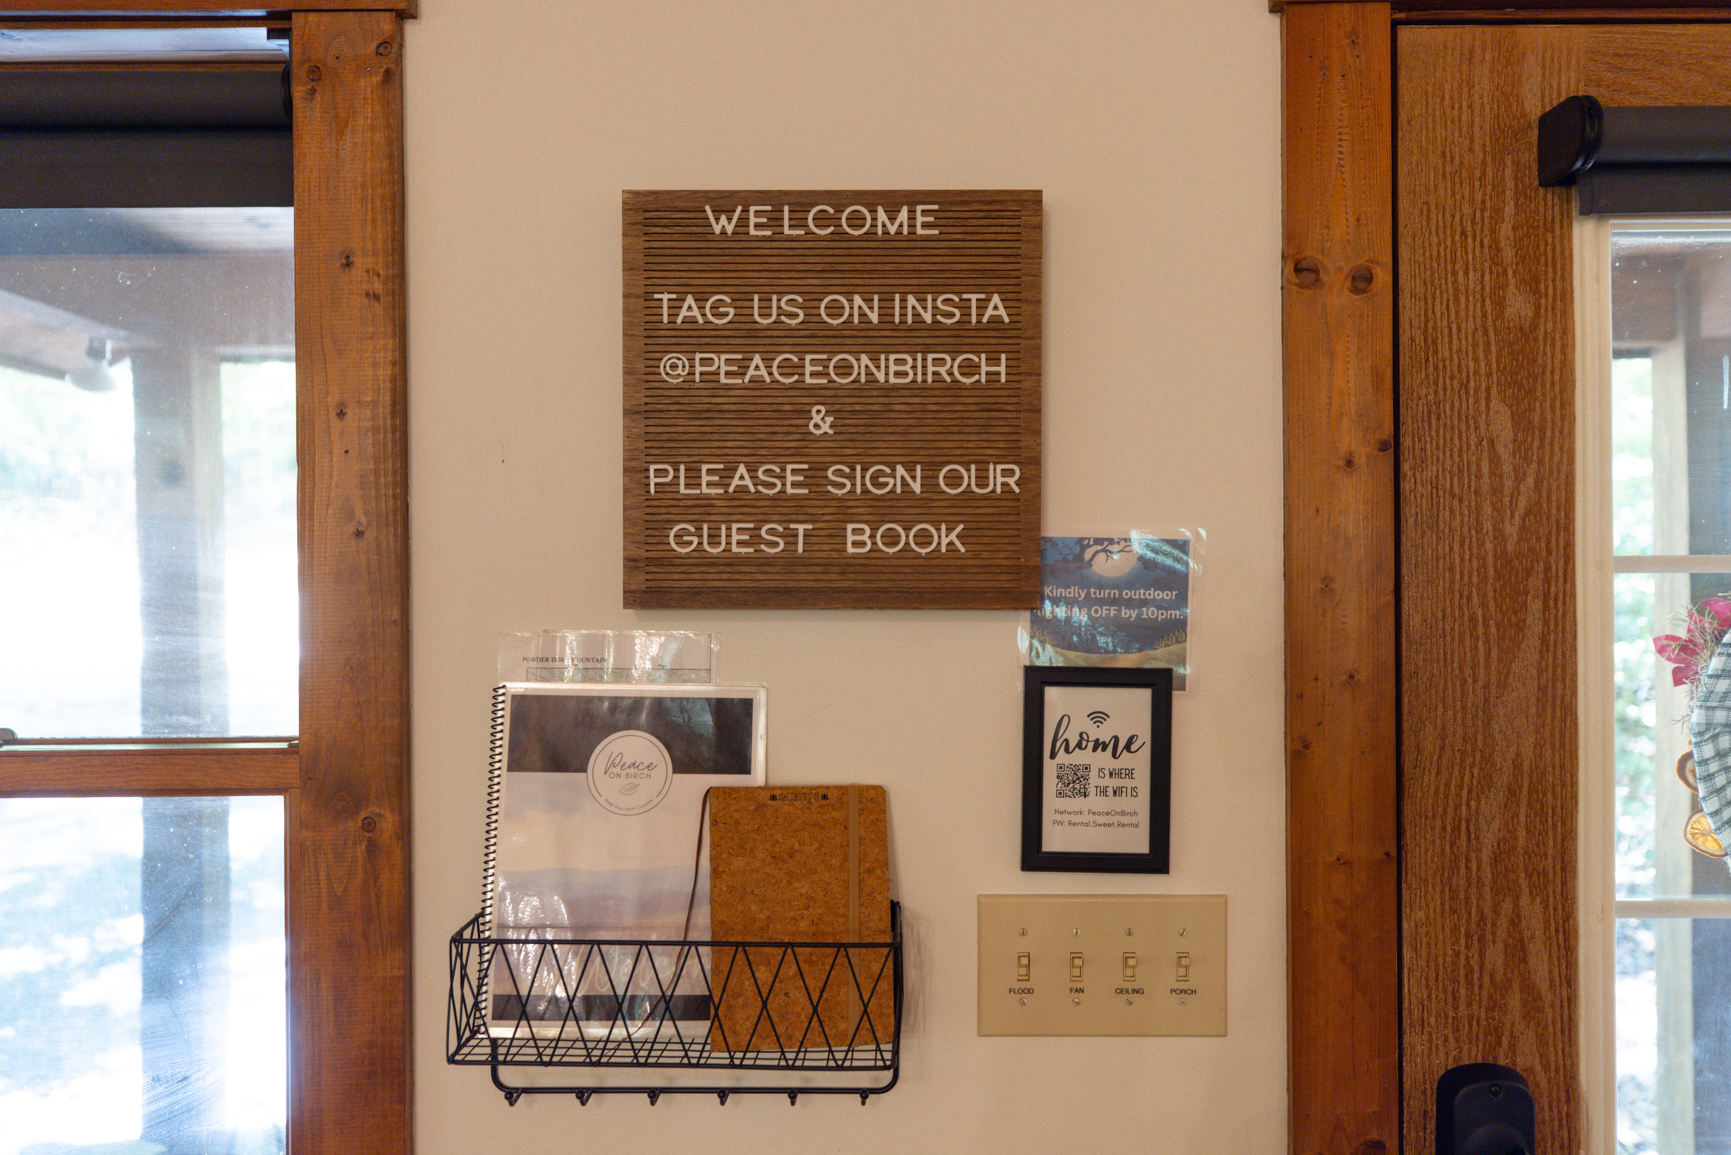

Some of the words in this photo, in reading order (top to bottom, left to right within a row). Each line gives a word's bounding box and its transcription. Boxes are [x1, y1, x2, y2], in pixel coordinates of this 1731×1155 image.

[705, 205, 939, 236] WELCOME
[654, 292, 735, 325] TAG
[754, 294, 804, 325] US
[820, 294, 879, 325] ON
[894, 293, 1010, 325] INSTA
[659, 352, 1007, 385] @PEACEONBIRCH
[808, 405, 835, 436] &
[649, 463, 809, 496] PLEASE
[826, 464, 922, 496] SIGN
[938, 462, 1021, 496] OUR
[669, 523, 813, 555] GUEST
[846, 522, 966, 555] BOOK
[1044, 585, 1087, 601] Kindly
[1090, 587, 1119, 599] turn
[1122, 587, 1178, 600] outdoor
[1091, 606, 1118, 617] OFF
[1121, 606, 1138, 621] by
[1141, 606, 1184, 621] 10pm.
[1049, 714, 1146, 760] home
[604, 751, 658, 775] Peace
[625, 772, 652, 780] BIRCH
[1097, 767, 1106, 779] IS
[1108, 767, 1136, 780] WHERE
[1094, 785, 1110, 798] THE
[1112, 785, 1128, 798] WIFI
[1130, 786, 1139, 798] IS
[1054, 808, 1086, 816] Network:
[1087, 808, 1139, 817] PeaceOnBirch
[1052, 819, 1066, 827] PW:
[1067, 820, 1140, 828] Rental.Sweet.Rental
[1009, 987, 1034, 995] FLOOD
[1115, 987, 1145, 995] CEILING
[1170, 988, 1197, 996] PORCH
